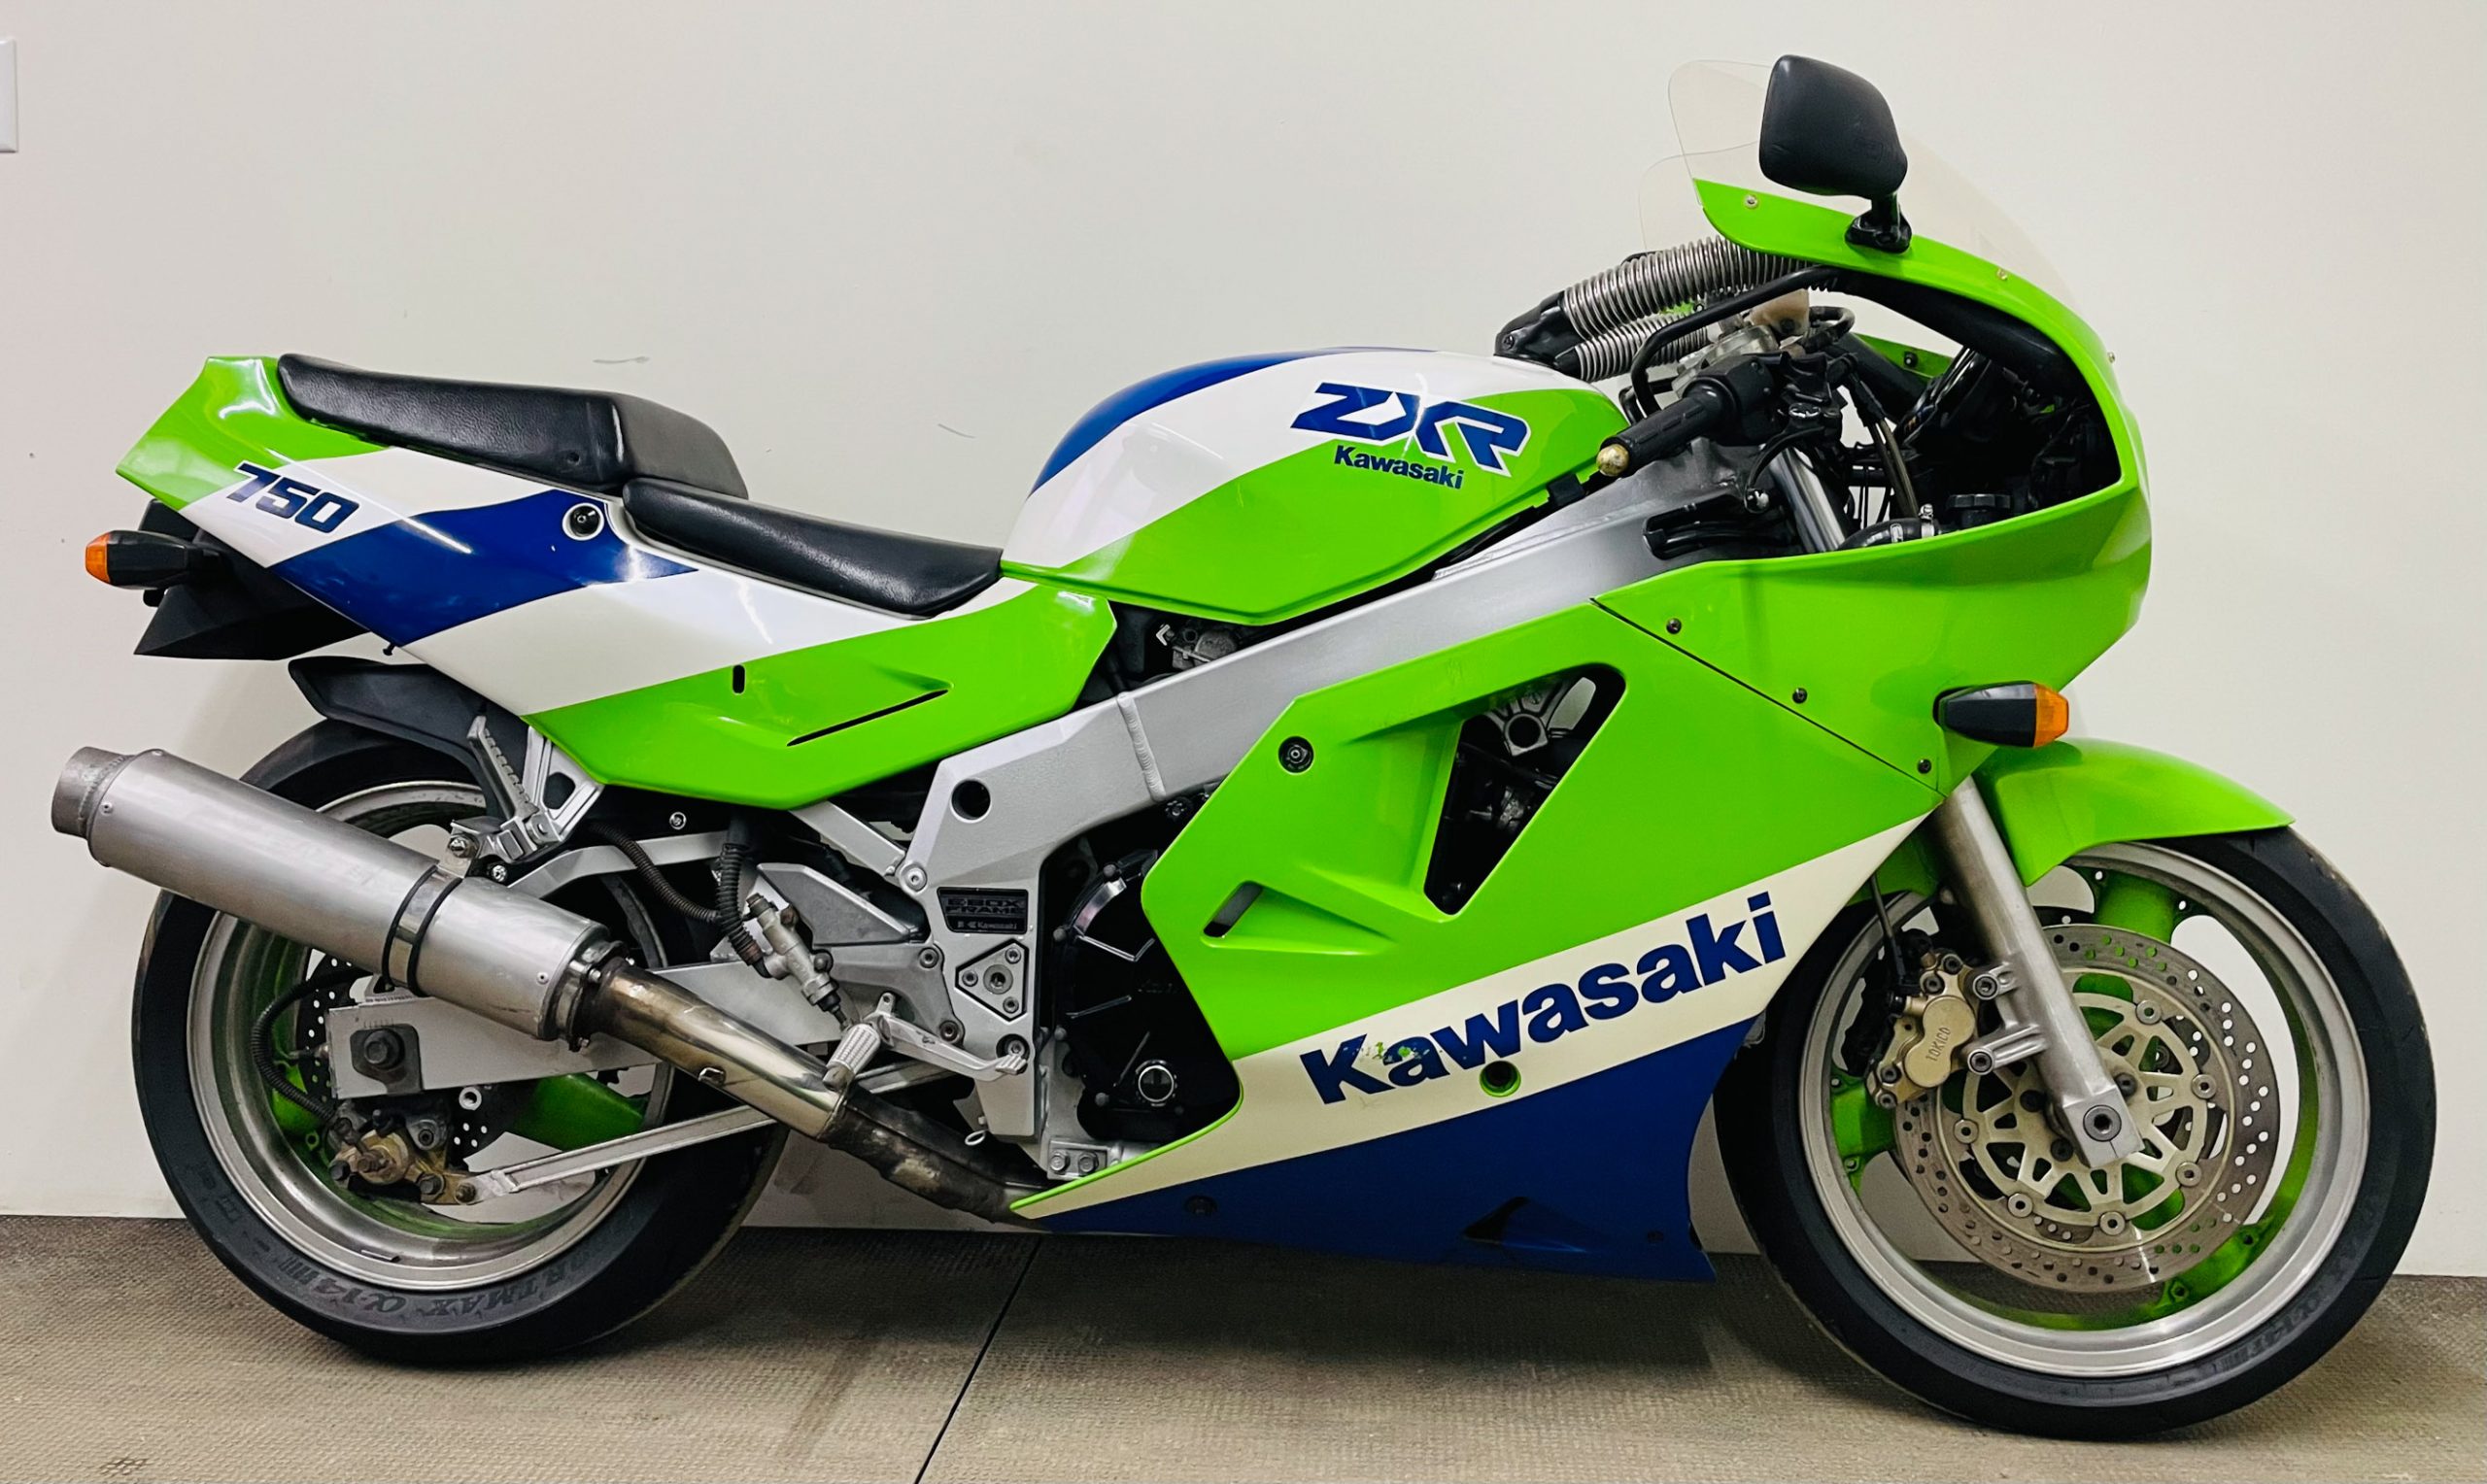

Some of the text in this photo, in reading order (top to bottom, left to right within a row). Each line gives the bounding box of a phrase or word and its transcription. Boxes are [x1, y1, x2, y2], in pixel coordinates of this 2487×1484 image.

[1289, 381, 1530, 473] ZXR
[226, 462, 360, 533] 750
[1334, 444, 1464, 489] Kawasaki
[1299, 890, 1787, 1105] Kawasaki
[1925, 1027, 1952, 1062] TOKICO
